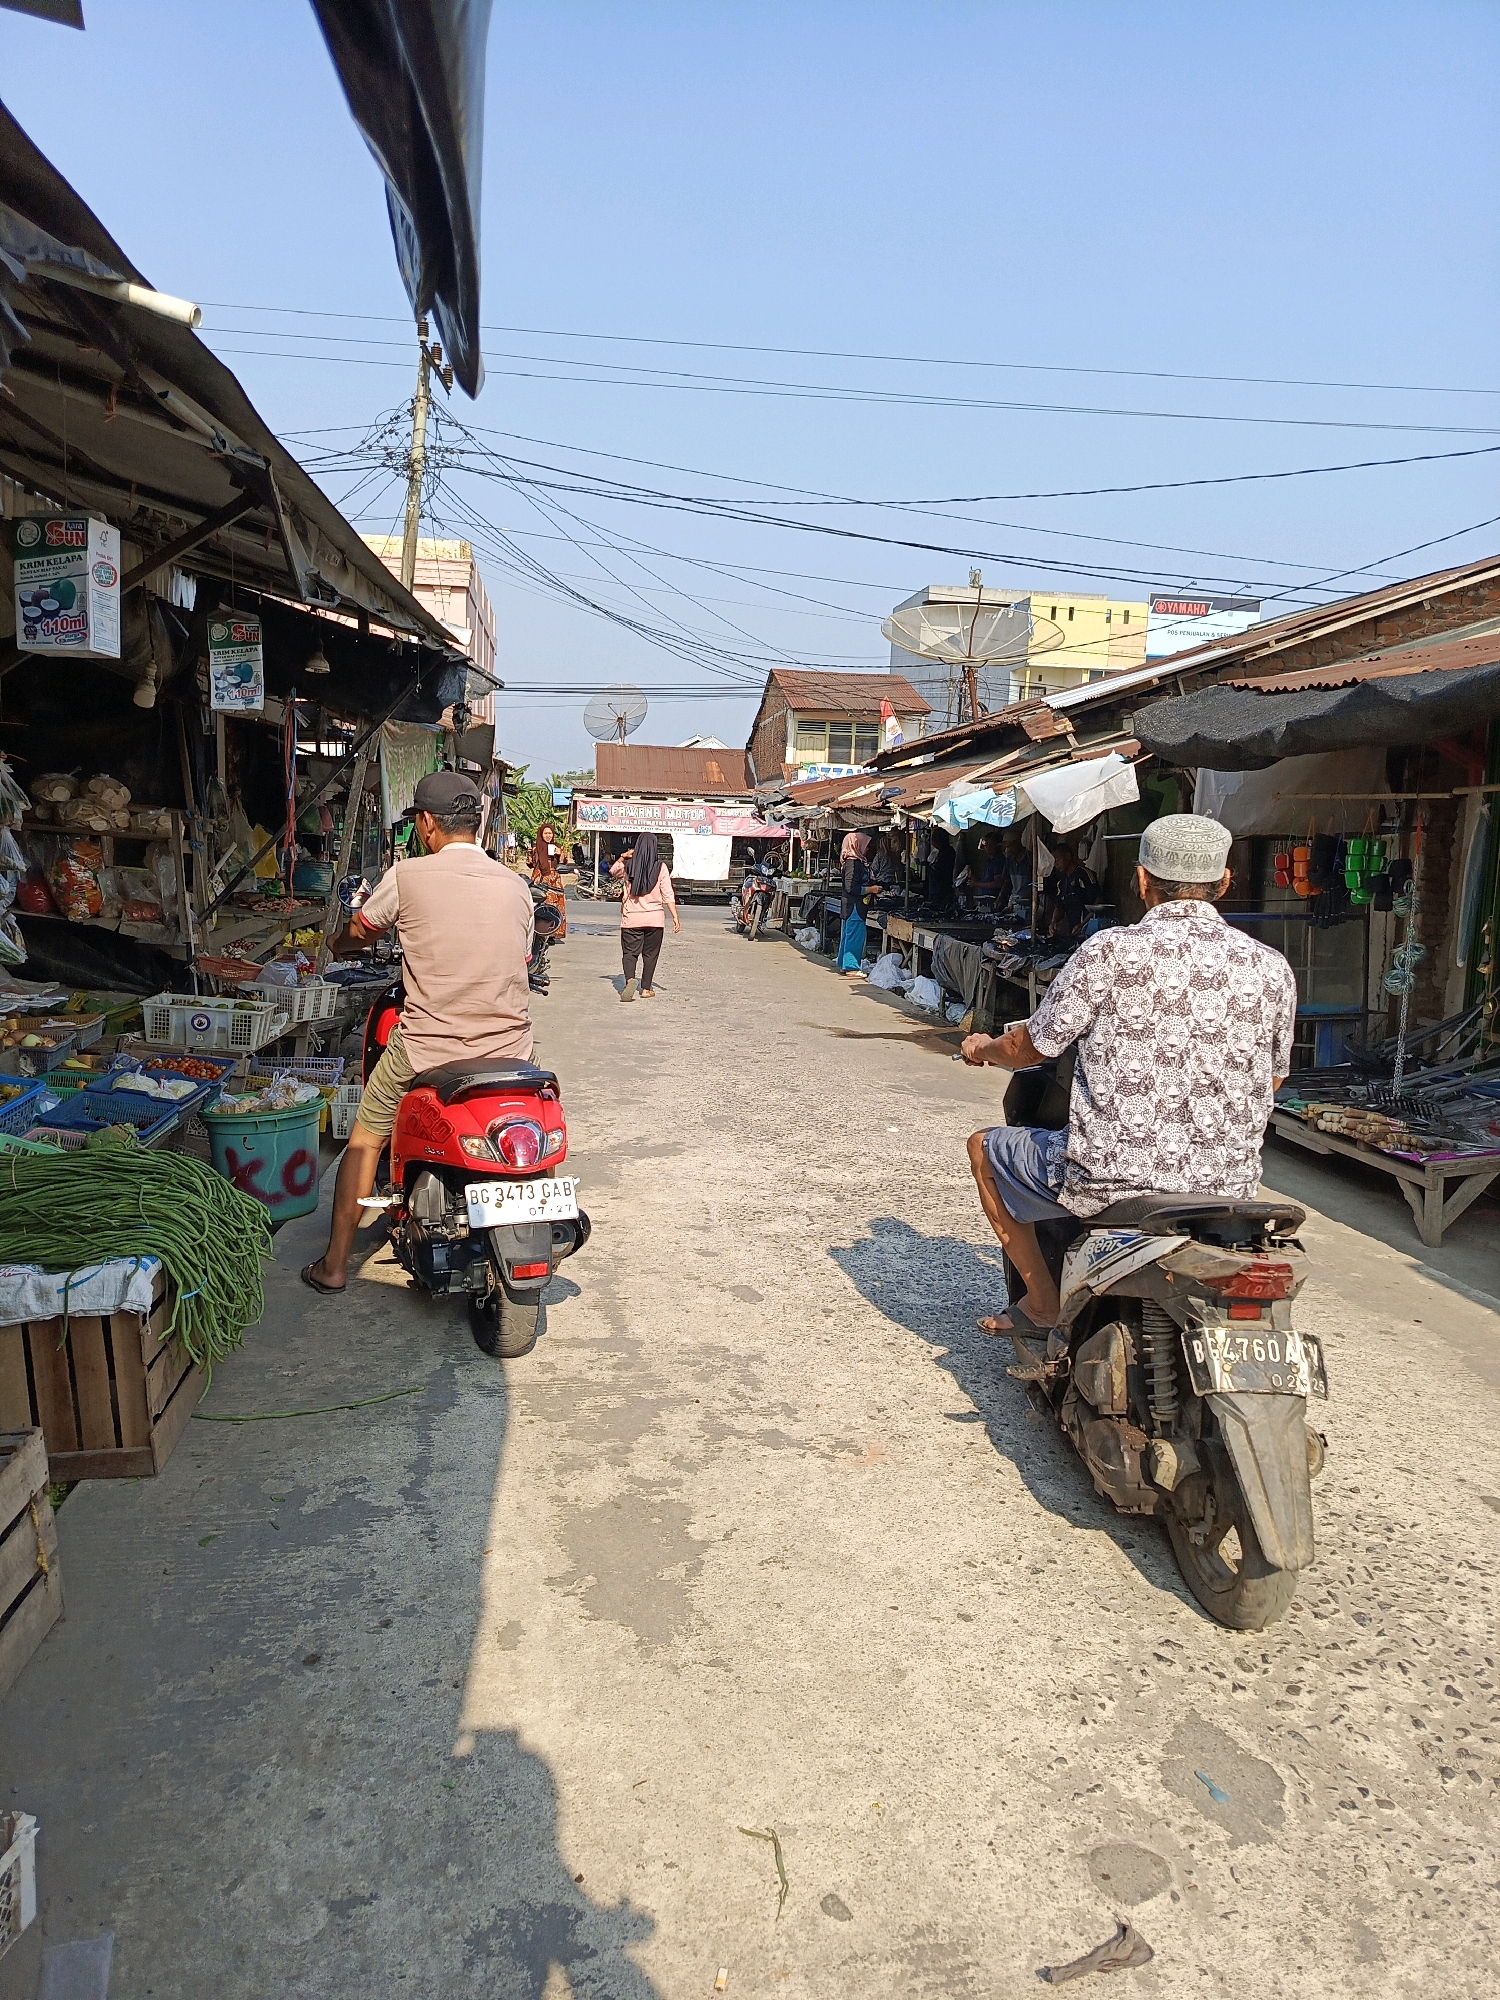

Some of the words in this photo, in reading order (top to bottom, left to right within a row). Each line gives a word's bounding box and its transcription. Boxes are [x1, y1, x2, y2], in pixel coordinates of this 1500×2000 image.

[20, 560, 45, 570] KRIM
[46, 554, 84, 567] KELAPA
[1167, 602, 1207, 615] YAMAHA
[43, 614, 87, 635] 110ml
[665, 807, 706, 821] MOTOR
[470, 1189, 490, 1205] BG
[495, 1184, 535, 1203] 3473
[542, 1181, 572, 1198] GAB
[1222, 1337, 1281, 1363] 4760
